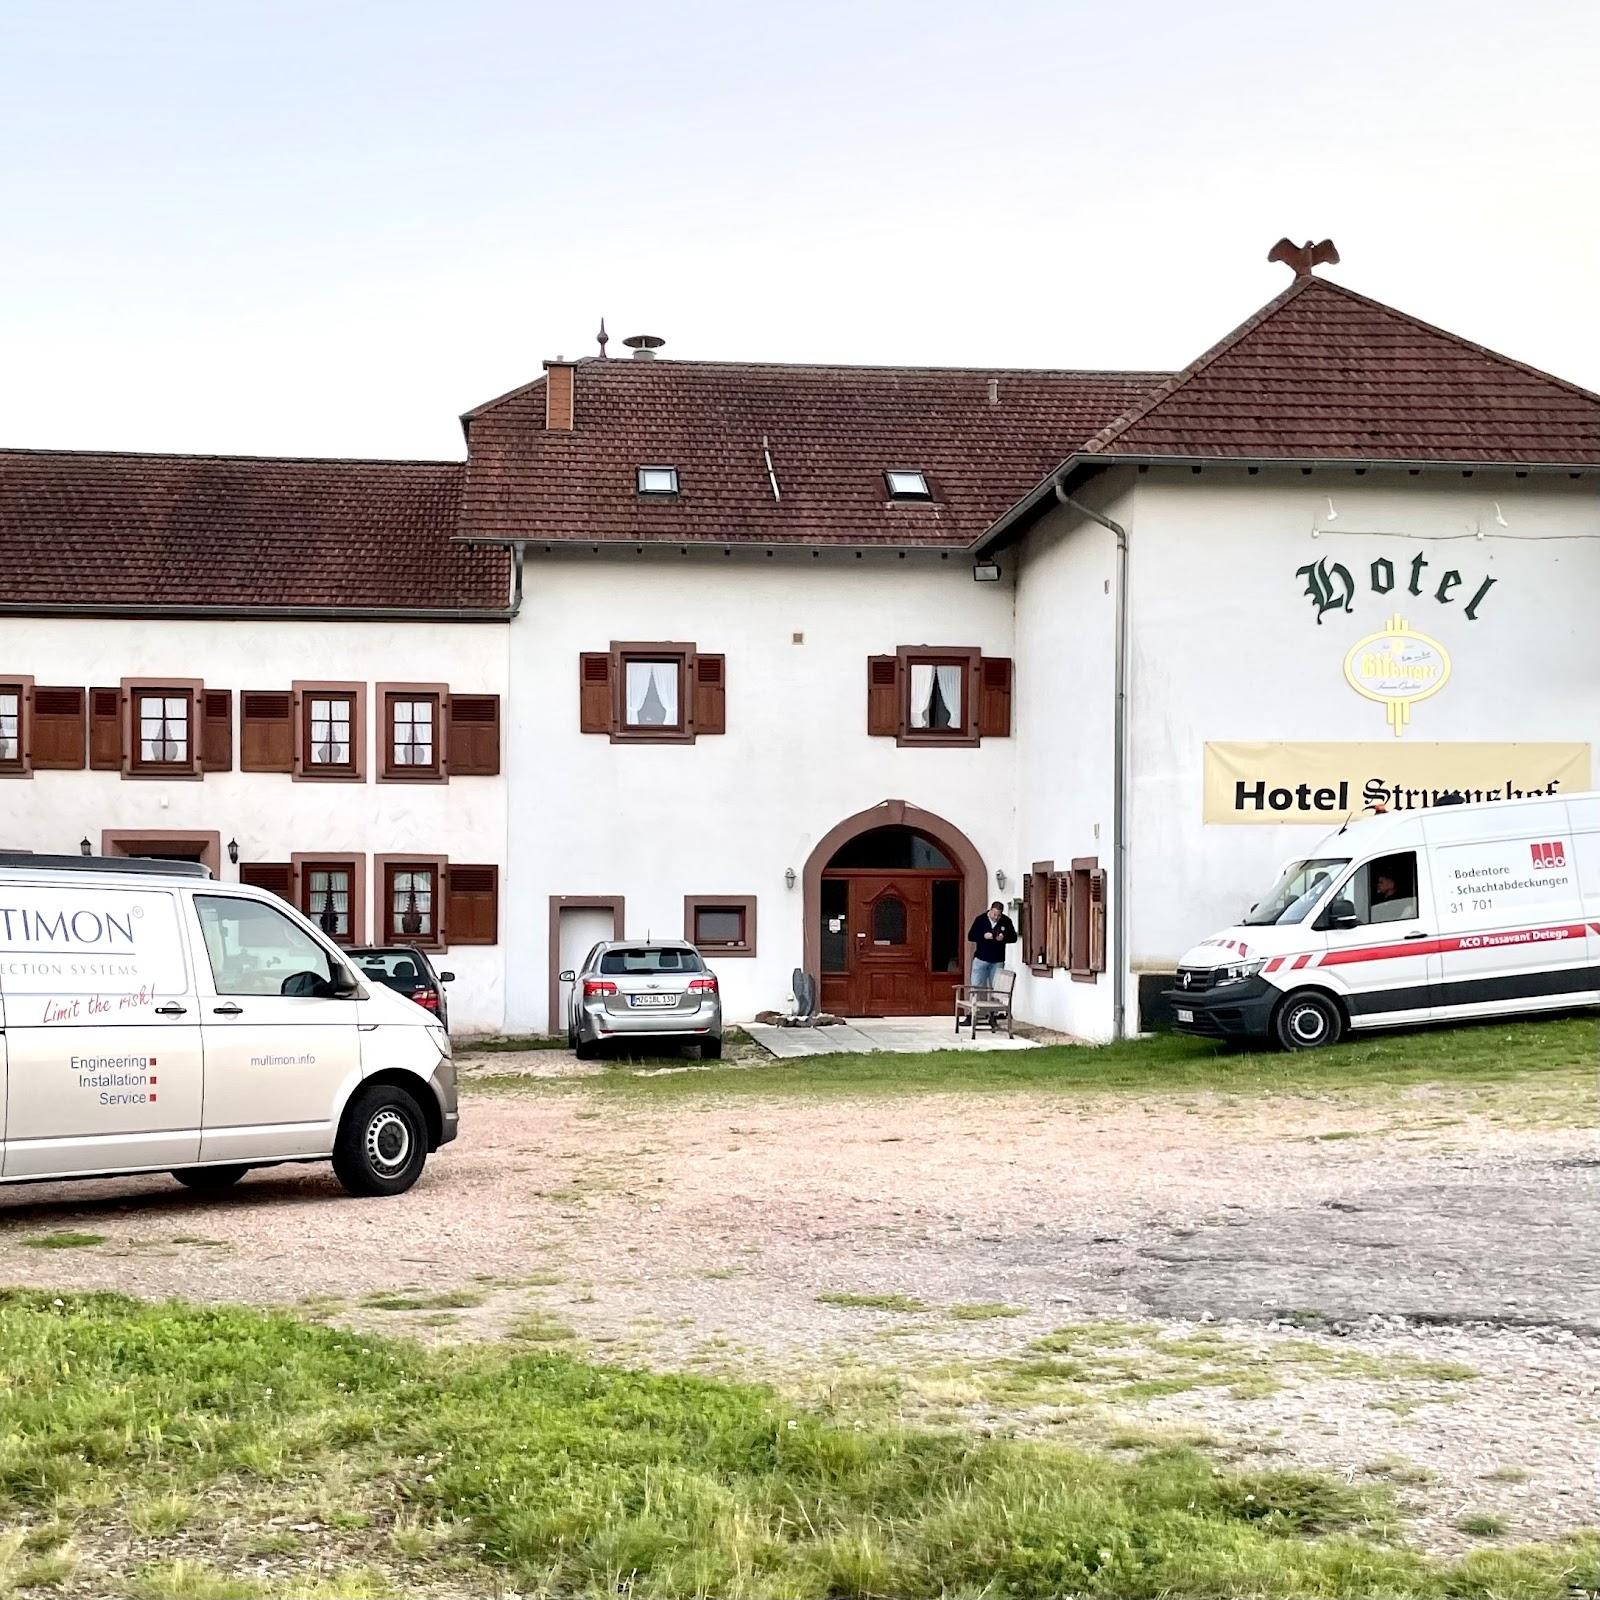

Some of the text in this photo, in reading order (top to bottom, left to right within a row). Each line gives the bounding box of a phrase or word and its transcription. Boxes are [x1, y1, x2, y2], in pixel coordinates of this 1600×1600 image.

[1295, 551, 1498, 625] Hotel
[1234, 781, 1349, 811] Hotel
[1454, 866, 1510, 879] Bodentore
[1457, 876, 1568, 895] Schachtabdeckungen
[1450, 899, 1493, 914] 31 701
[1458, 928, 1568, 949] ACO Passavant Detego
[71, 963, 138, 976] SYSTEMS
[43, 999, 81, 1024] Limit
[88, 993, 112, 1015] the
[70, 1055, 147, 1072] Engineering
[79, 1074, 147, 1088] Installation
[99, 1092, 147, 1106] Service
